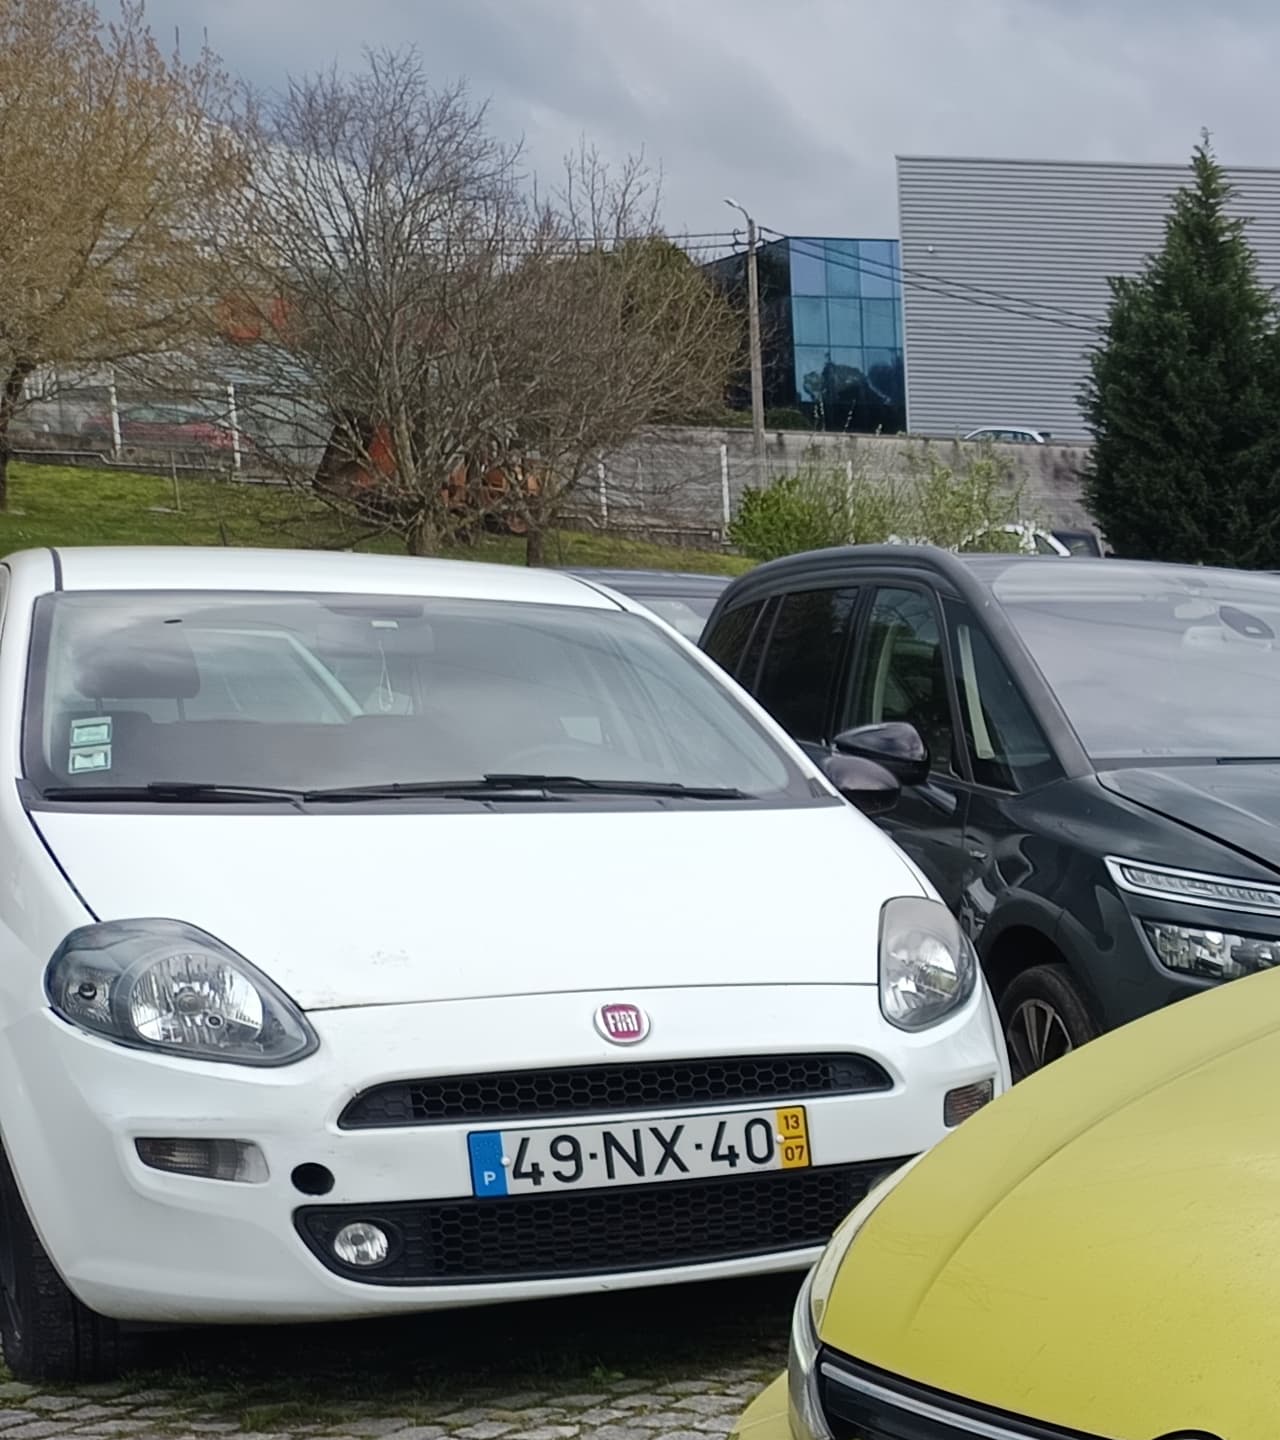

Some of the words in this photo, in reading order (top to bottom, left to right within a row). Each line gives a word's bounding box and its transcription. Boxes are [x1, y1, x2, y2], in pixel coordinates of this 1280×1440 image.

[606, 1010, 639, 1033] FIAT
[784, 1114, 800, 1131] 13
[784, 1144, 804, 1162] 07
[483, 1170, 497, 1186] P
